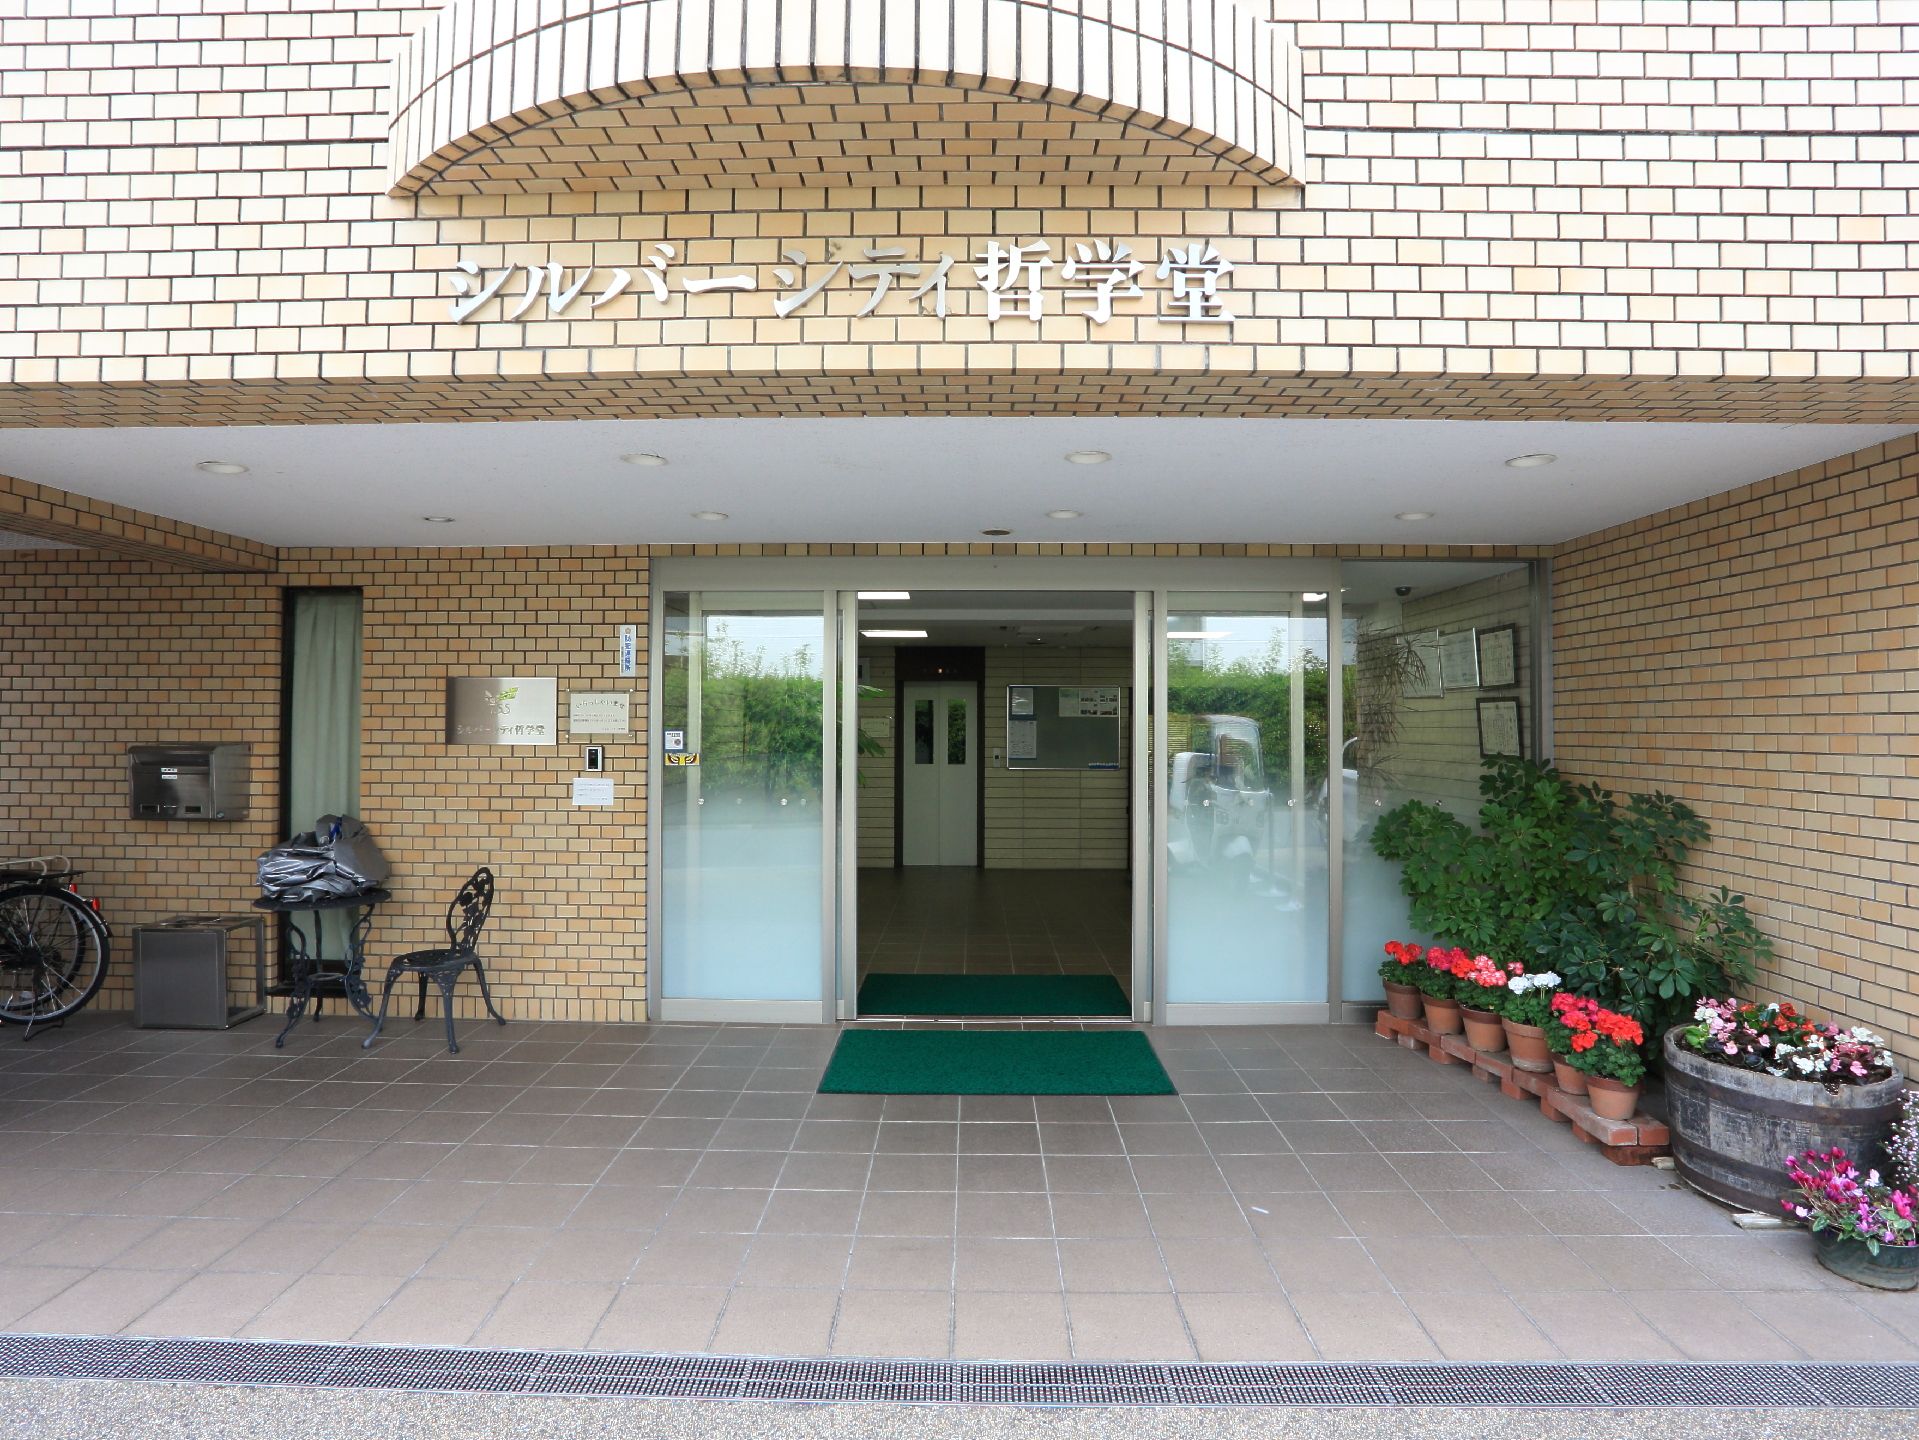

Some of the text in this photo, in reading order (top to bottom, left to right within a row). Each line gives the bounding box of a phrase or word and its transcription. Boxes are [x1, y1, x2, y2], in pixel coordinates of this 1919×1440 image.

[448, 238, 1235, 325] シルバーシティ哲学堂
[456, 724, 546, 736] シルバーティ哲学堂
